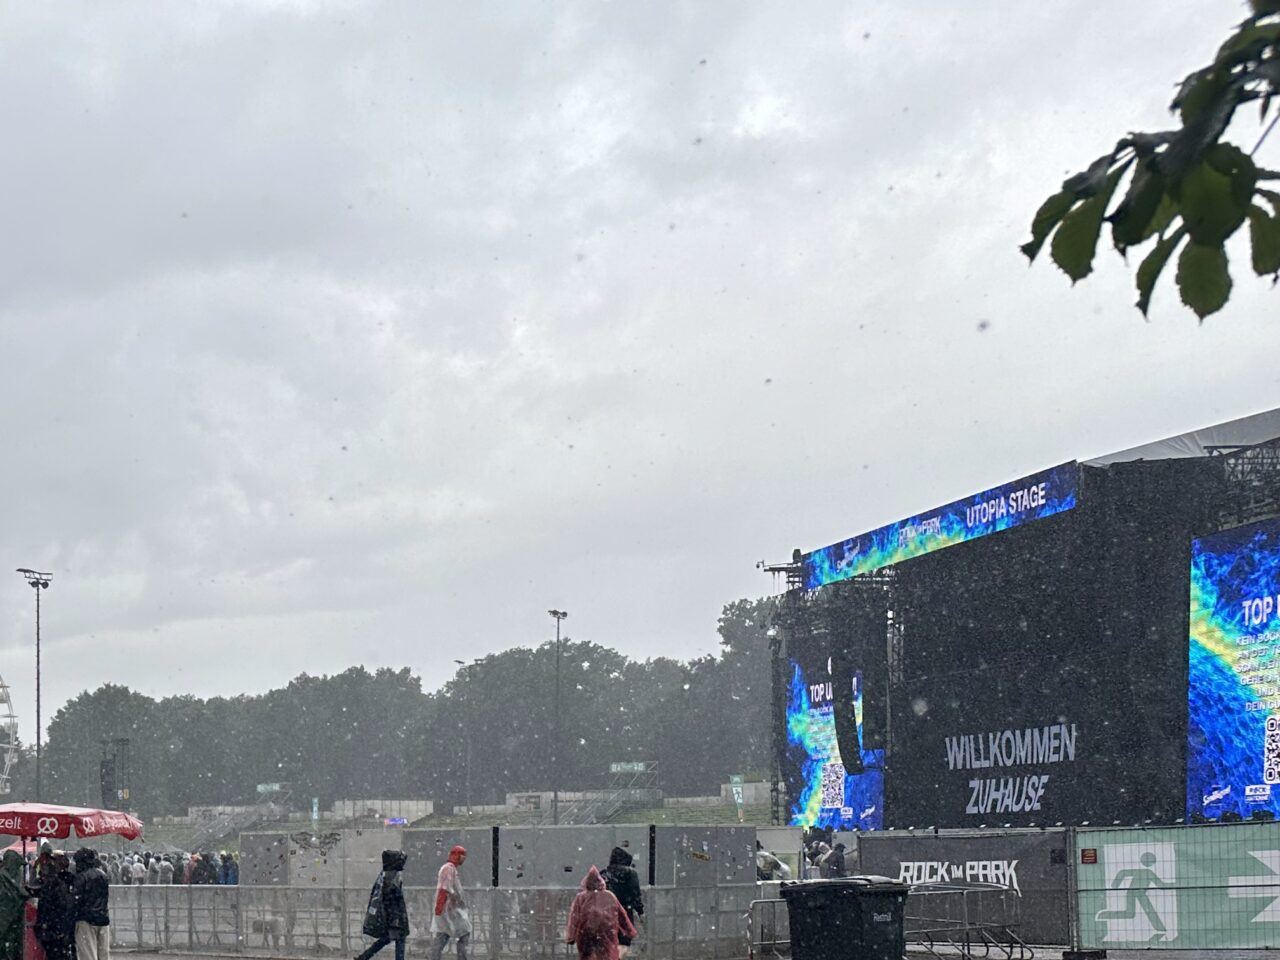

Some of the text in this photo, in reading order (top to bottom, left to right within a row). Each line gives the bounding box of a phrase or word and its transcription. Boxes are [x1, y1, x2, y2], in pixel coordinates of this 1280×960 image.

[966, 482, 1046, 528] UTOPIA STAGE
[1242, 596, 1273, 626] TOP
[810, 683, 824, 702] TOP
[945, 724, 1076, 770] WILLKOMMEN
[966, 775, 1050, 814] ZUHAUSE
[899, 860, 1022, 897] ROCK IM PARK
